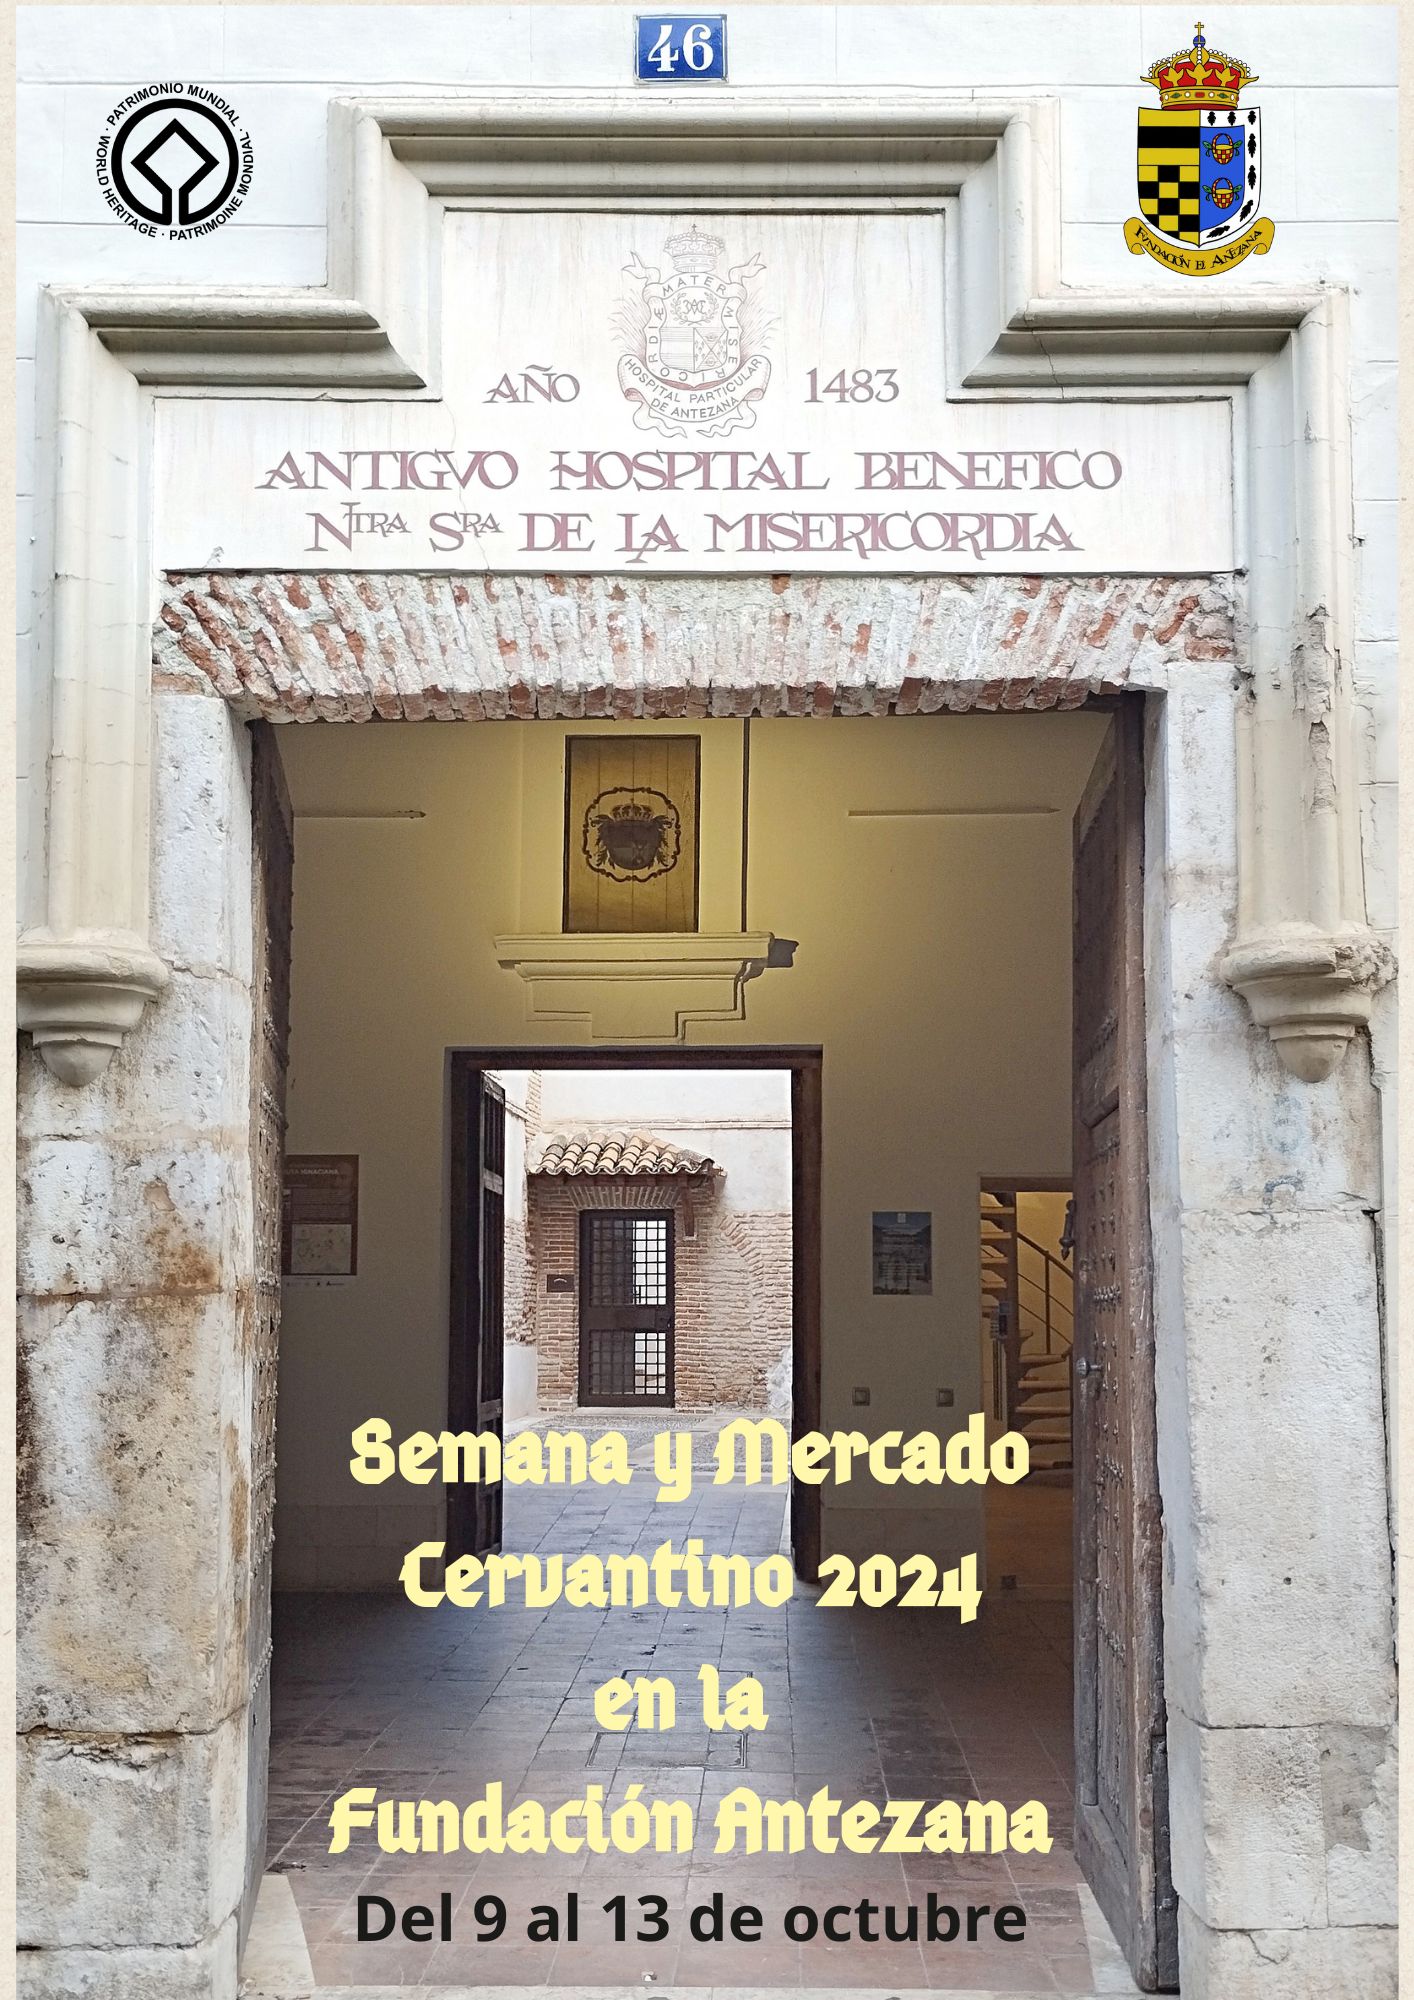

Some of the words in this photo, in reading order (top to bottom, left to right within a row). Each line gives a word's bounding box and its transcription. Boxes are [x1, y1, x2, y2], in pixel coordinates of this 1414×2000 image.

[648, 24, 713, 72] 46
[662, 275, 727, 297] MATER
[481, 364, 581, 404] AÑO
[804, 367, 900, 404] 1483
[624, 358, 681, 403] HOSPITAL
[689, 357, 762, 404] PARTICULAR
[651, 397, 669, 413] DE
[671, 396, 740, 419] ANTEZANA
[254, 448, 519, 491] ANTIGVO
[549, 448, 831, 492] HOSPITAL
[854, 448, 1123, 490] BENEFICO
[517, 512, 596, 553] DE
[613, 512, 690, 564] LA
[703, 509, 1085, 561] MISERICORDIA
